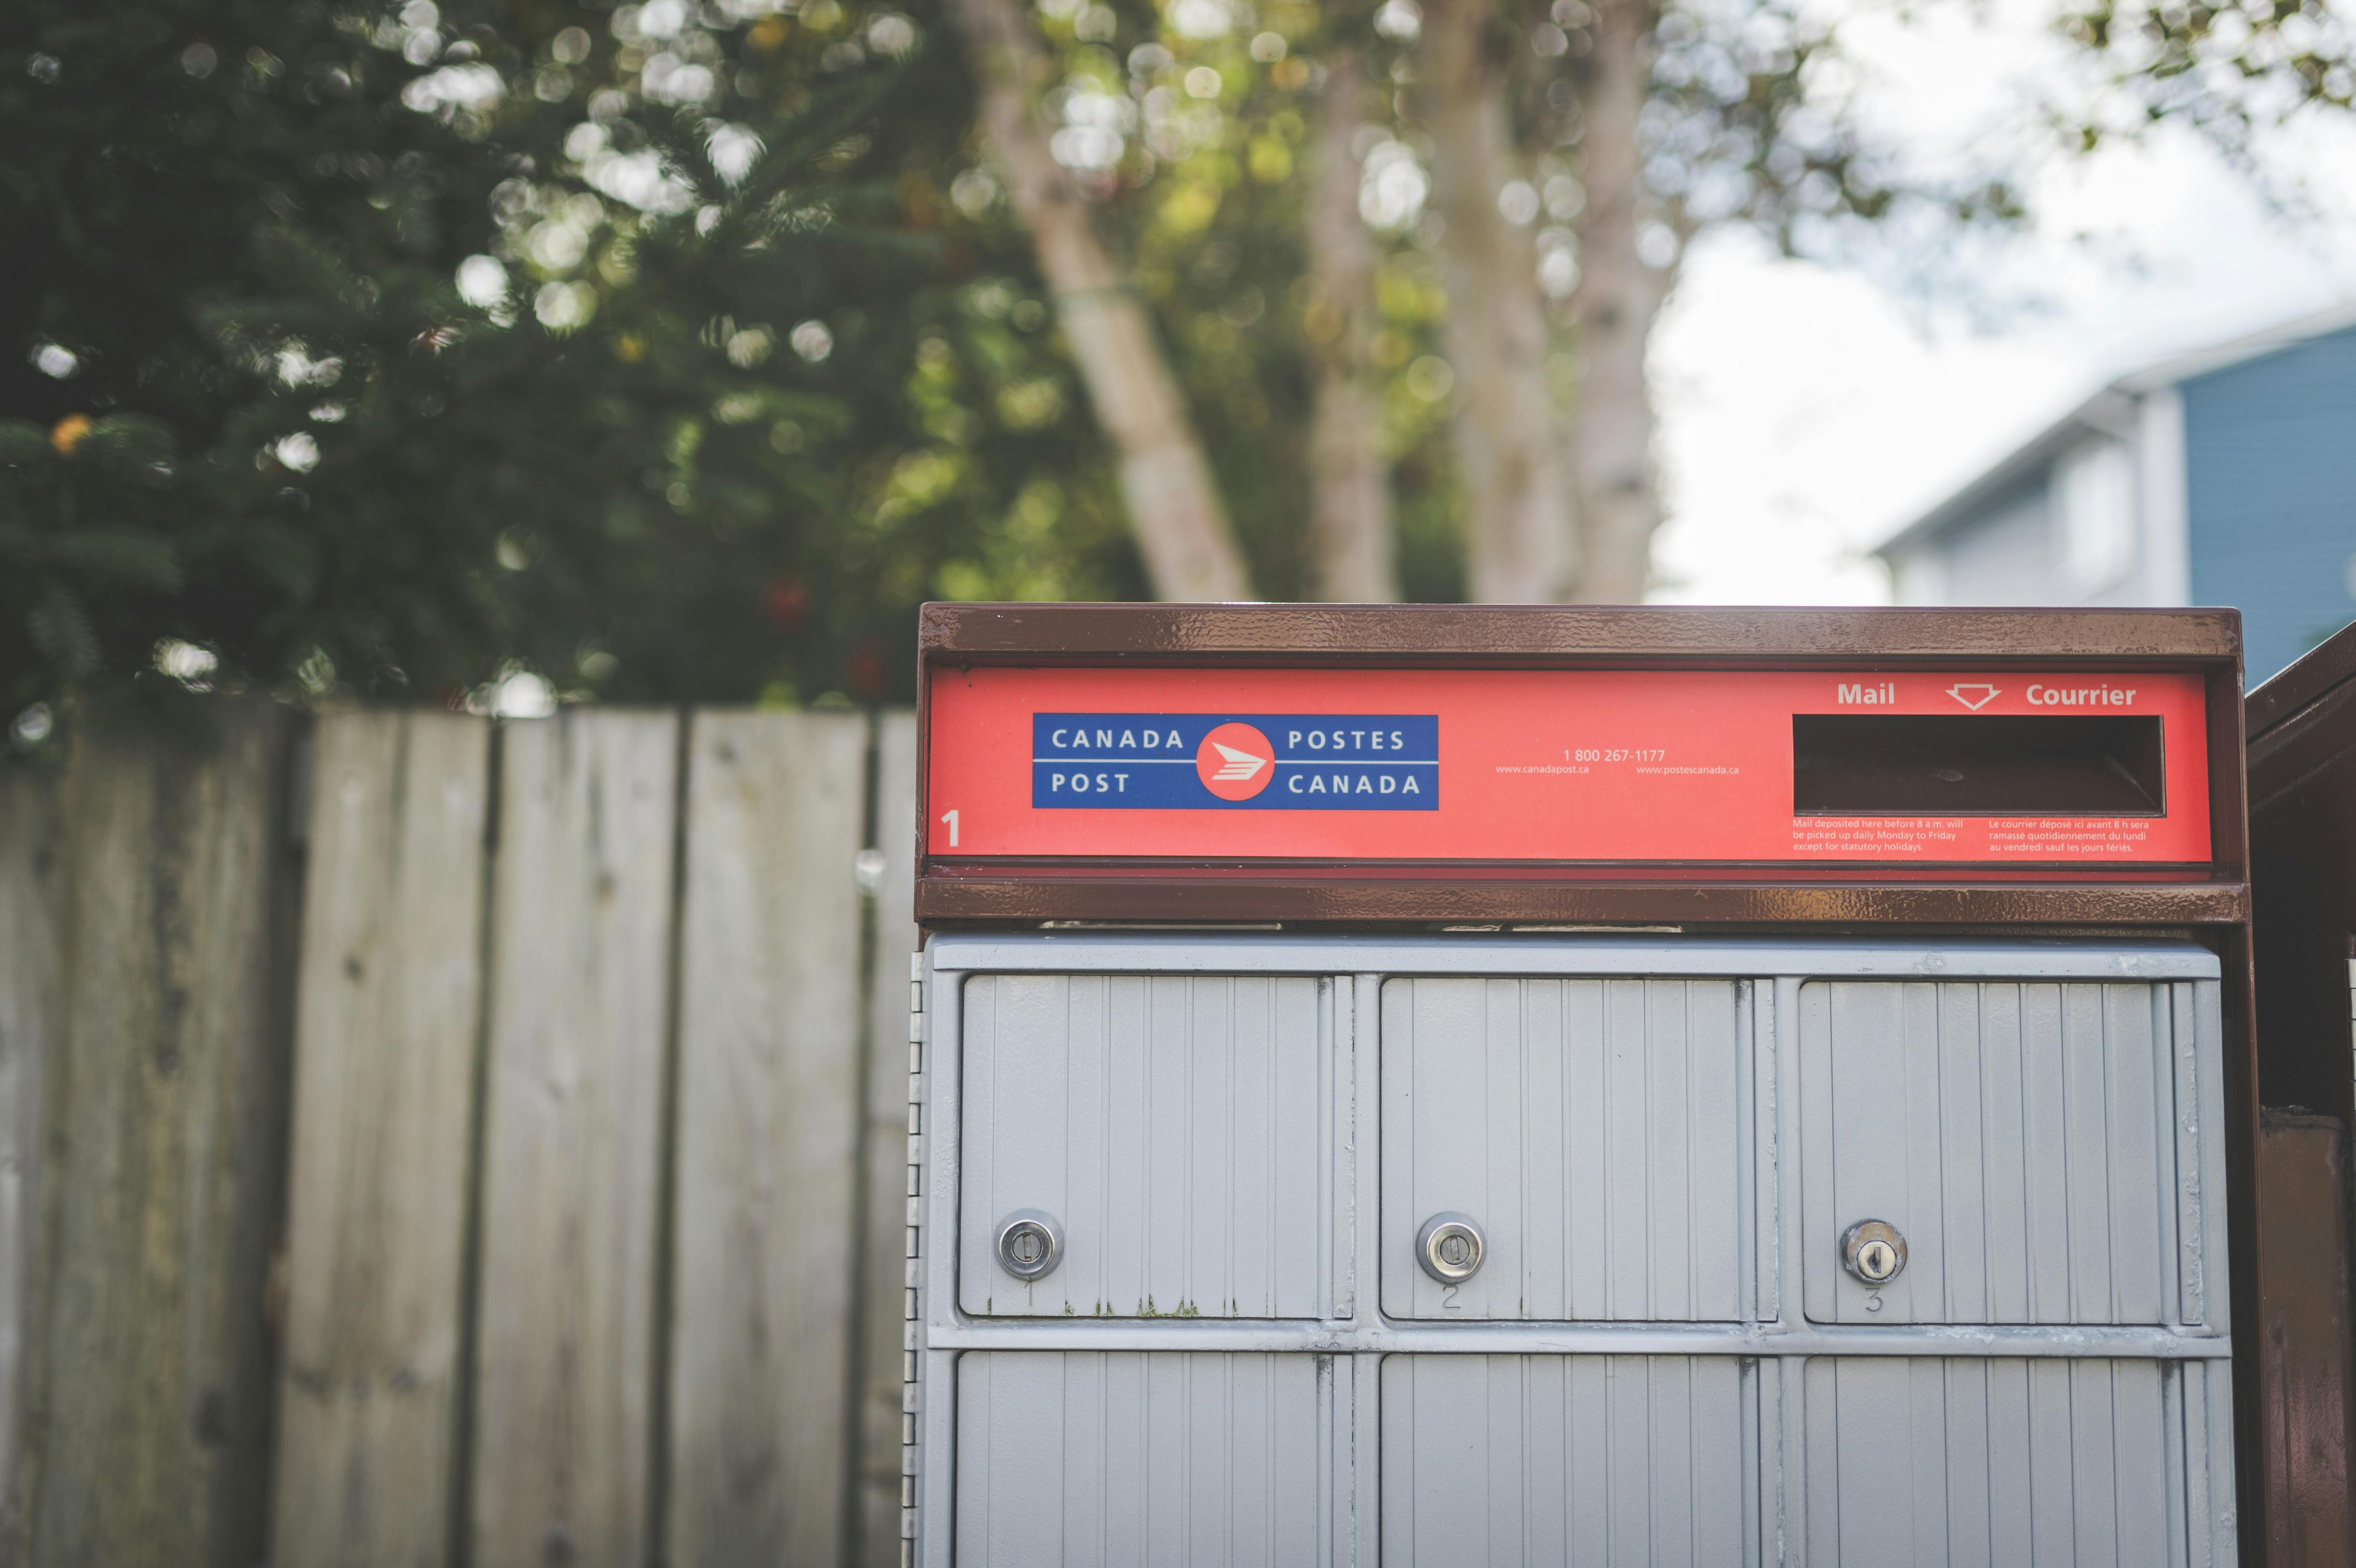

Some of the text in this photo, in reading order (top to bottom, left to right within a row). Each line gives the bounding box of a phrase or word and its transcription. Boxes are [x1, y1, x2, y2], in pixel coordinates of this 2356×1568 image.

[1838, 683, 1895, 704] Mail
[2027, 684, 2136, 705] Courrier
[1052, 729, 1183, 748] CANADA
[1289, 730, 1403, 750] POSTES
[1564, 749, 1665, 762] 1 800 267-1177
[1496, 765, 1589, 775] www.canadapost.ca
[1636, 766, 1739, 776] www.postescanada.ca
[1052, 773, 1128, 792] POST
[1288, 774, 1420, 794] CANADA
[941, 810, 959, 847] 1
[1793, 819, 1812, 827] Mail
[1815, 819, 1859, 829] deposited
[1862, 819, 1883, 827] here
[1885, 819, 1914, 828] before
[1917, 820, 1923, 828] 8
[1947, 820, 1963, 828] will
[1989, 820, 1999, 828] Le
[2001, 820, 2037, 828] courrier
[2040, 820, 2072, 830] déposé
[2114, 820, 2120, 829] 8
[2122, 820, 2128, 828] h
[1793, 830, 1804, 839] be
[1807, 831, 1836, 841] picked
[1853, 830, 1874, 841] daily
[1877, 831, 1914, 841] Monday
[1928, 831, 1956, 841] Friday
[2028, 832, 2106, 841] quotidiennement
[2109, 832, 2120, 840] du
[2123, 832, 2146, 840] lundi
[1793, 841, 1923, 853] except for statutory holidays.
[2003, 842, 2043, 851] vendredi
[2046, 842, 2064, 851] sauf
[2067, 843, 2079, 851] les
[2081, 843, 2104, 853] jours
[2106, 842, 2133, 852] fériés.
[1023, 1281, 1033, 1307] 1
[1442, 1283, 1461, 1309] 2
[1865, 1287, 1883, 1312] 3
